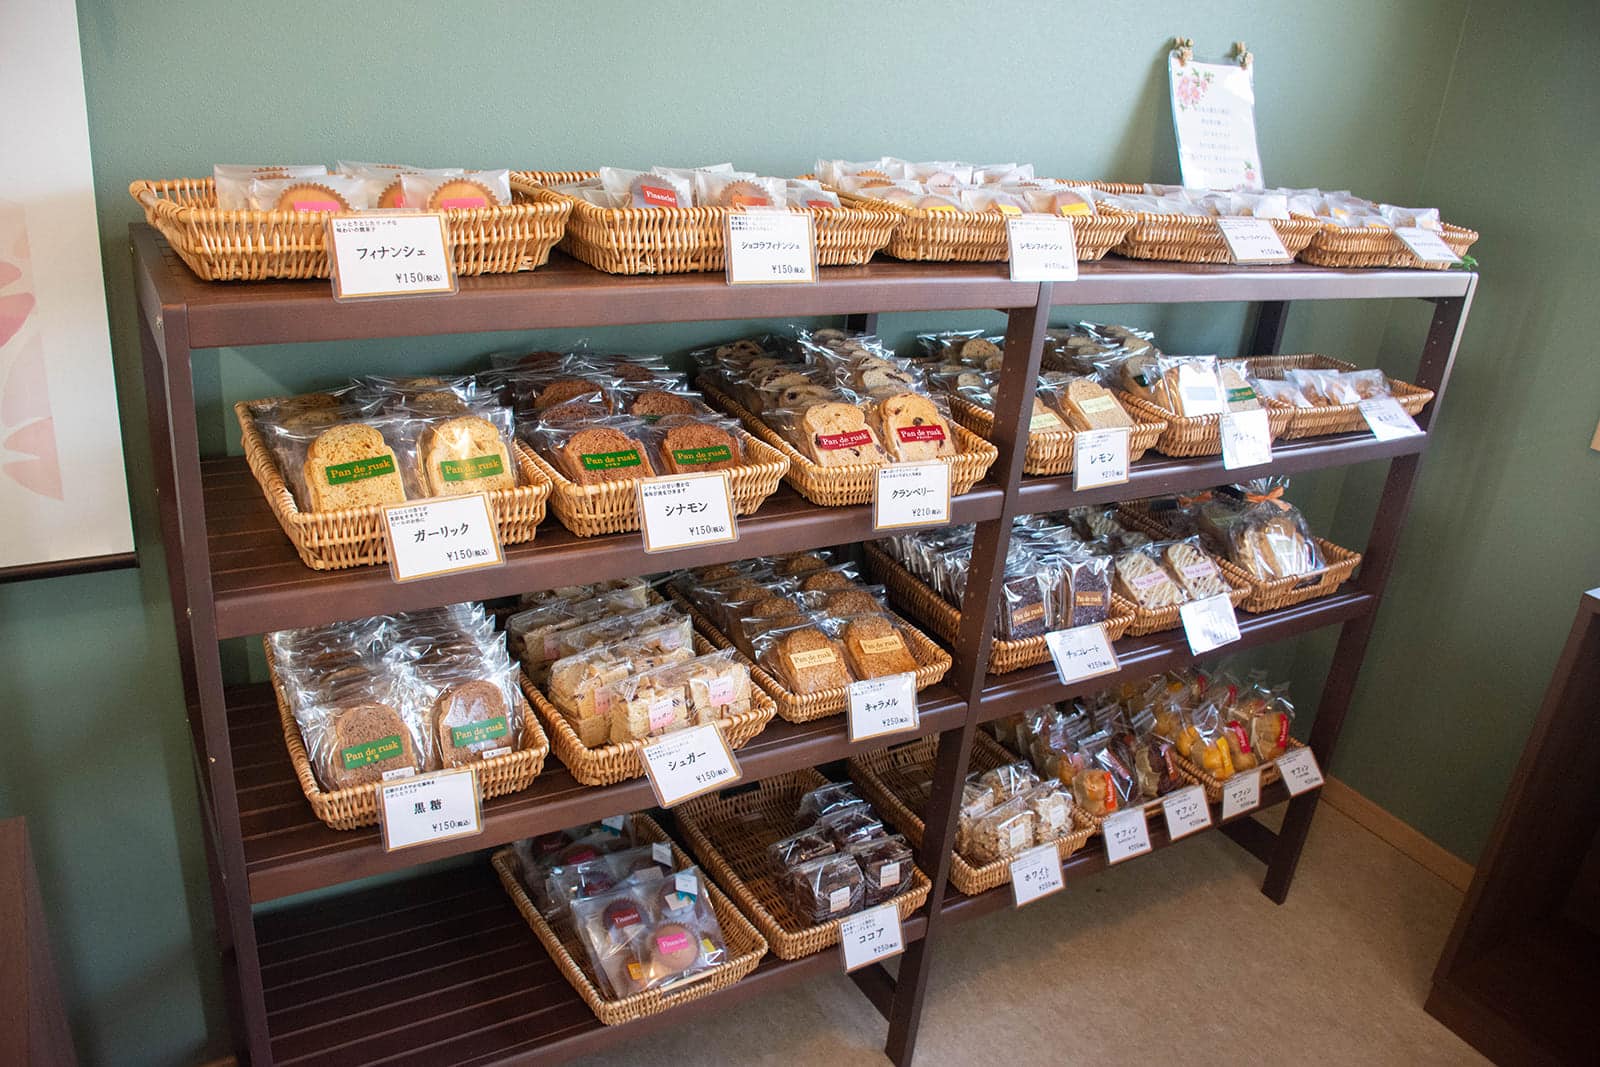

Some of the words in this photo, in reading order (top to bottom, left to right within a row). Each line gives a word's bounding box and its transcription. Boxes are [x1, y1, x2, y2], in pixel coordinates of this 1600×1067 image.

[741, 241, 800, 250] ショコラフィナンシェ
[356, 246, 426, 260] フィナンシェ
[822, 438, 838, 446] Pan
[839, 436, 848, 444] de
[900, 430, 916, 438] Pan
[585, 457, 604, 465] Pan
[677, 452, 694, 460] Pan
[1090, 453, 1114, 464] レモン
[330, 468, 352, 479] Pan
[353, 465, 366, 475] de
[367, 459, 391, 472] rusk
[445, 464, 464, 475] Pan
[477, 459, 499, 470] rusk
[891, 487, 935, 500] クランベリー
[665, 502, 708, 517] シナモン
[414, 522, 469, 543] ガーリック
[1066, 645, 1100, 658] チョコレート
[865, 698, 898, 712] キャラメル
[455, 730, 473, 741] Pan
[473, 726, 485, 736] de
[485, 722, 504, 733] rusk
[345, 751, 364, 763] Pan
[365, 747, 376, 757] de
[377, 740, 400, 754] rusk
[668, 751, 707, 771] シュガー
[1114, 827, 1138, 838] マフィン
[859, 927, 885, 944] ココア
